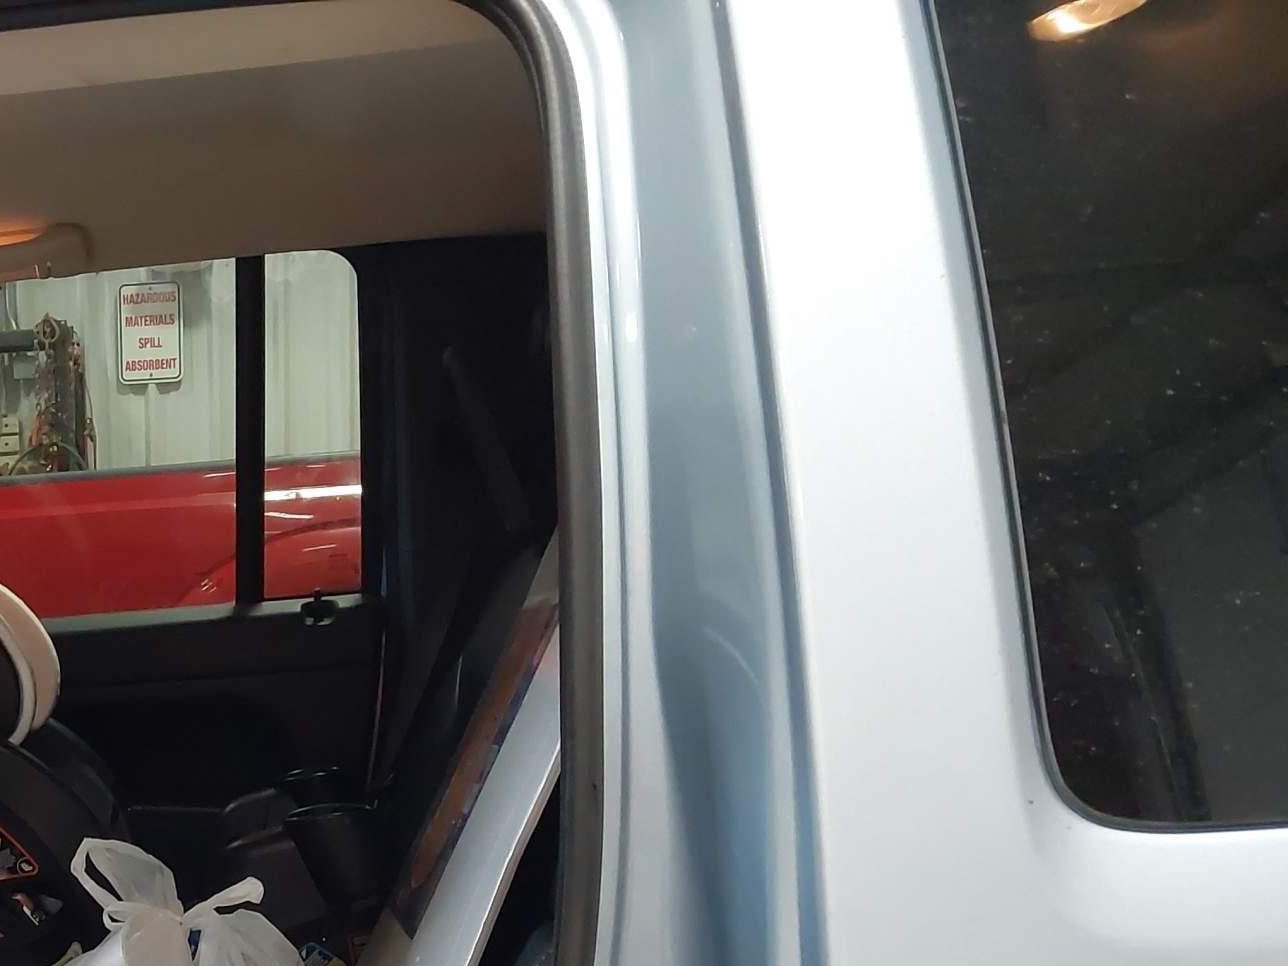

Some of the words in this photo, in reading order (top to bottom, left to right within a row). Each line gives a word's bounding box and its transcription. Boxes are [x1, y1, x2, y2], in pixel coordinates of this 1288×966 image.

[122, 291, 176, 305] HAZARDOUS
[124, 313, 175, 328] MATERIALS
[138, 336, 162, 349] SPILL
[124, 358, 177, 372] ABSORBENT
